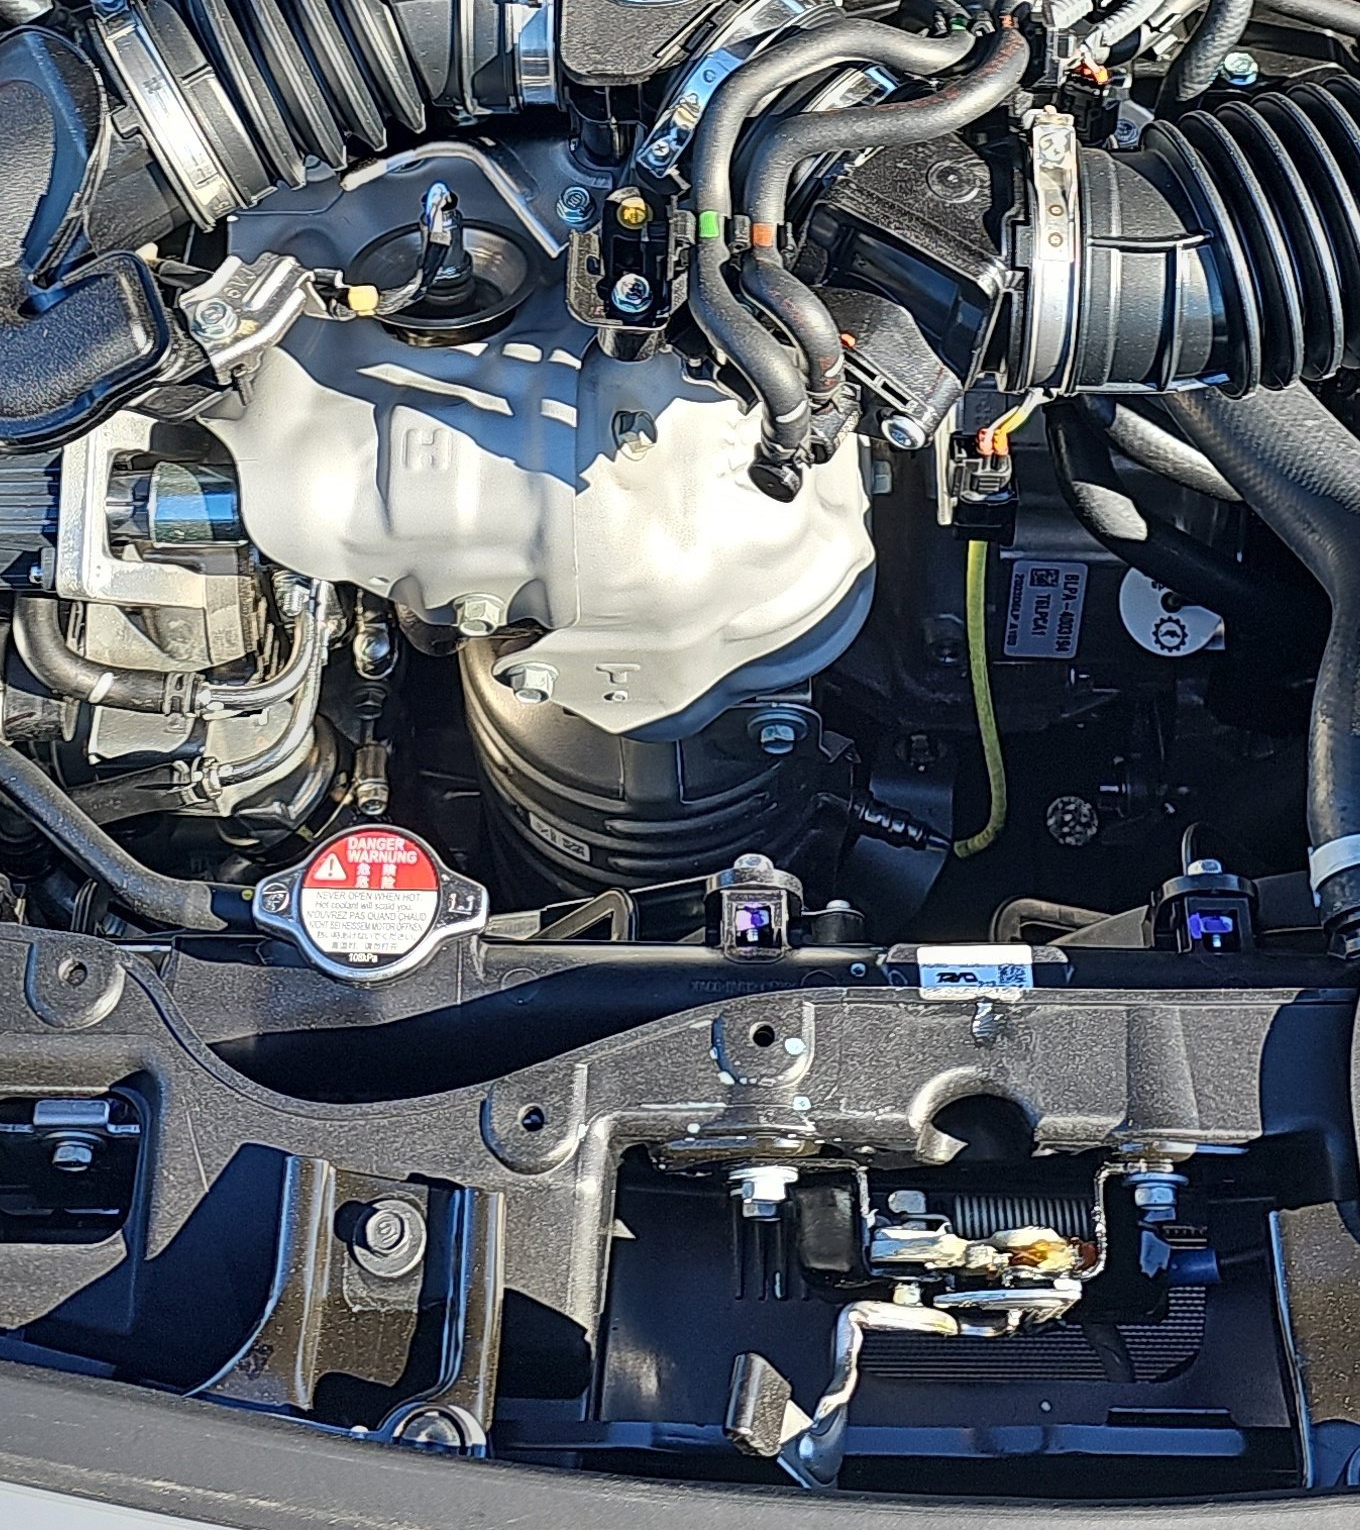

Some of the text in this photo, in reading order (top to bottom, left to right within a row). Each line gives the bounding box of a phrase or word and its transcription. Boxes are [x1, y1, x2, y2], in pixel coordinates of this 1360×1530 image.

[347, 837, 405, 850] DANGER
[347, 850, 418, 864] WARNUNG
[317, 892, 345, 900] NEVER
[348, 892, 372, 900] OPEN
[374, 893, 400, 901] WHEN
[349, 912, 366, 920] PAS
[368, 912, 396, 920] QUAND
